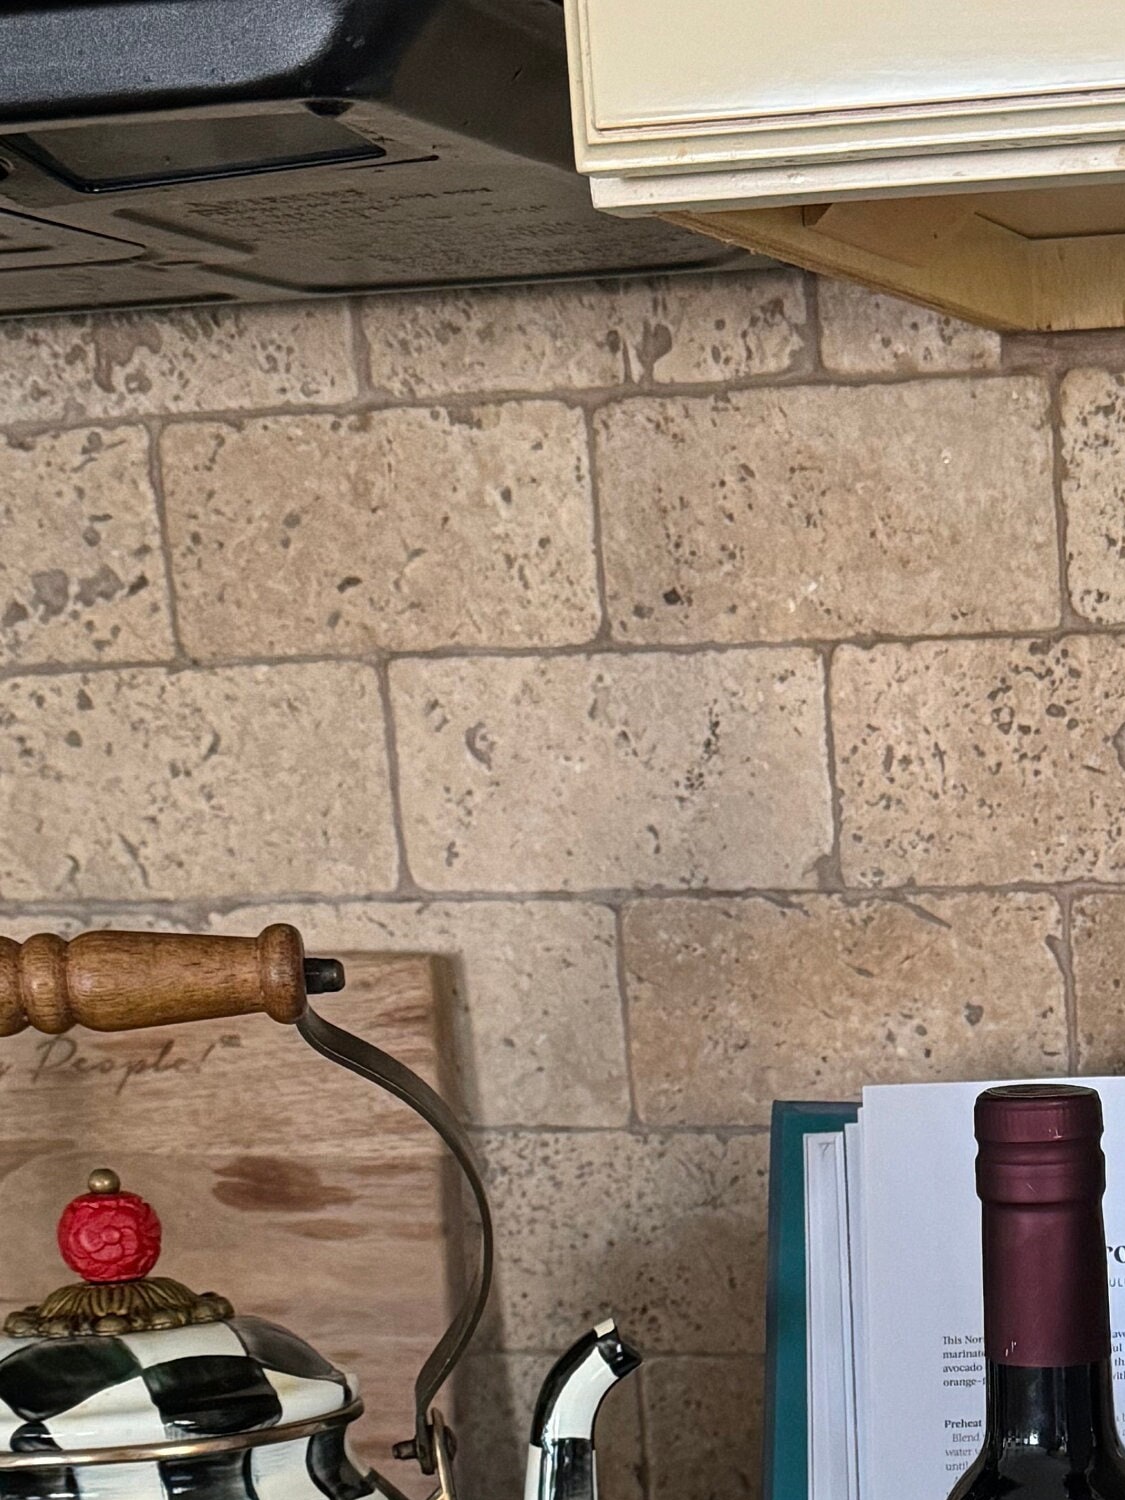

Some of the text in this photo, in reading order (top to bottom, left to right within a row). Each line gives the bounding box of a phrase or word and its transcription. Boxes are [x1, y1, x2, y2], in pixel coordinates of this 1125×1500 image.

[943, 1335, 962, 1345] This
[943, 1362, 983, 1373] avocado
[944, 1418, 982, 1429] Preheat
[952, 1431, 980, 1443] Blend
[945, 1448, 972, 1457] water
